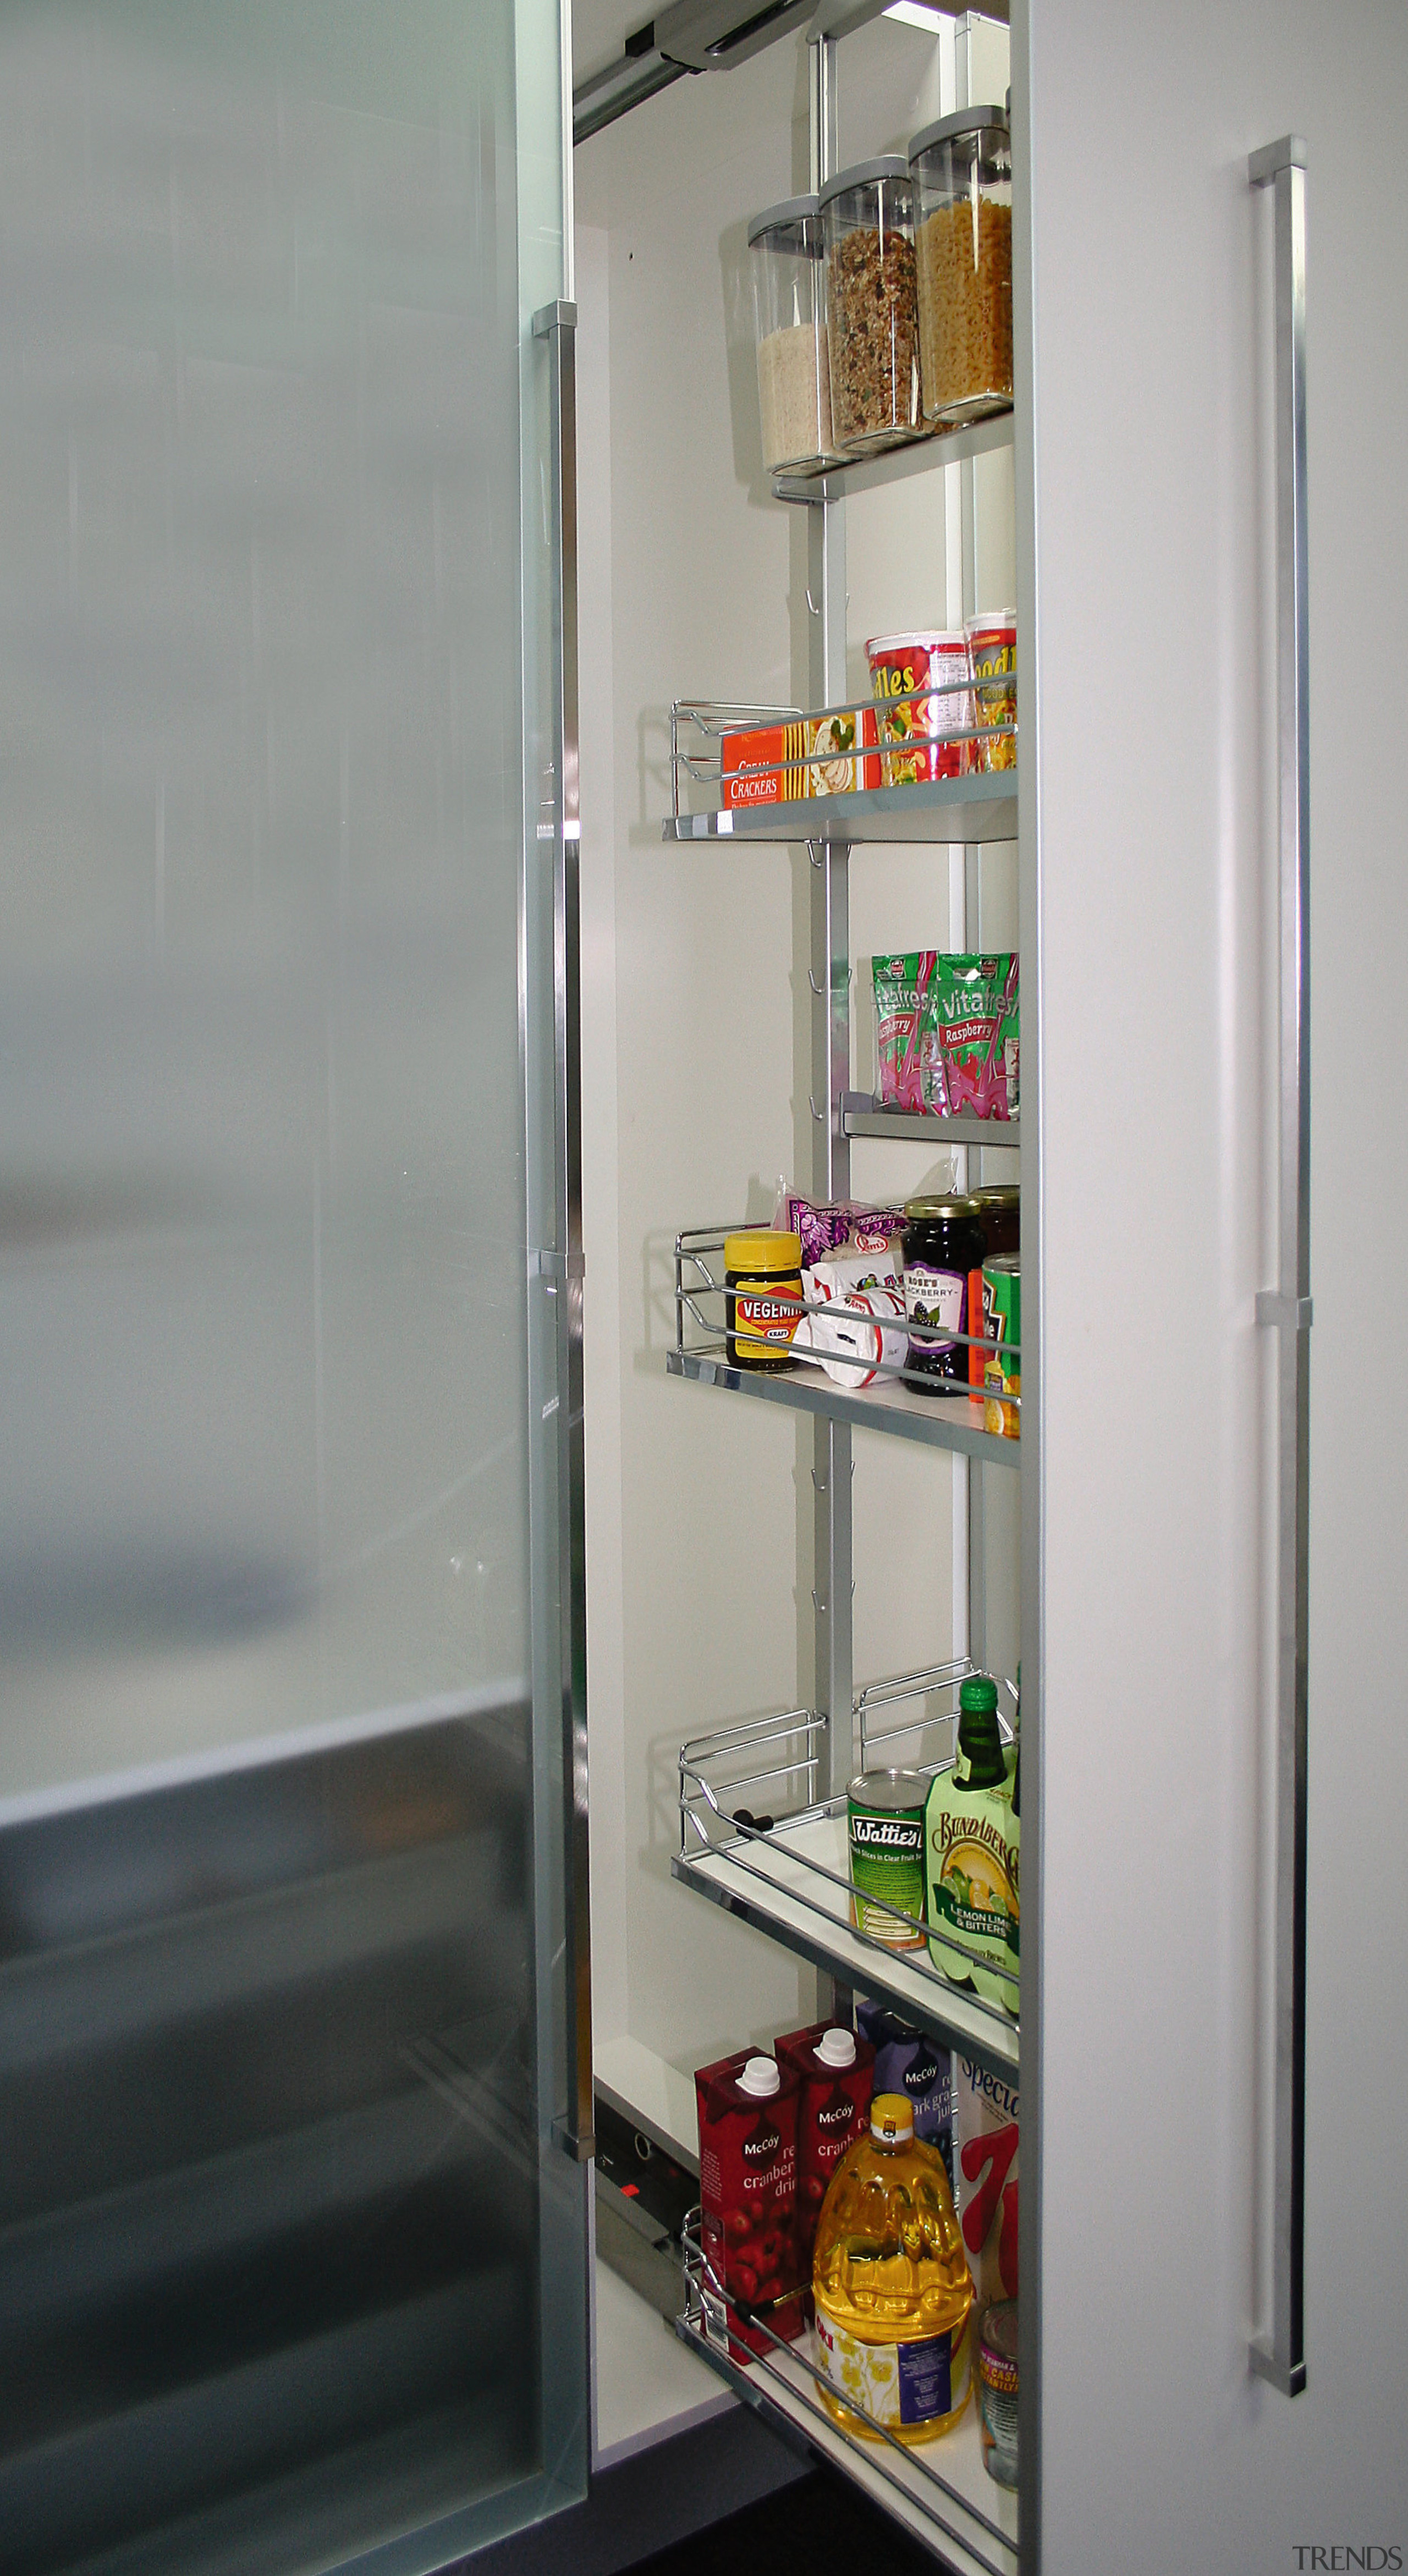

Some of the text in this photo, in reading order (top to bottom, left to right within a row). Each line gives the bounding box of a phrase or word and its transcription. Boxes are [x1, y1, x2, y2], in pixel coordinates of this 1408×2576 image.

[731, 778, 777, 799] CRACKERS
[946, 1023, 992, 1042] Raspberry
[744, 1301, 801, 1318] VEGEMI
[856, 1821, 917, 1846] Wattie's
[950, 1903, 987, 1922] LEMON
[956, 1917, 1007, 1937] & BITTERS
